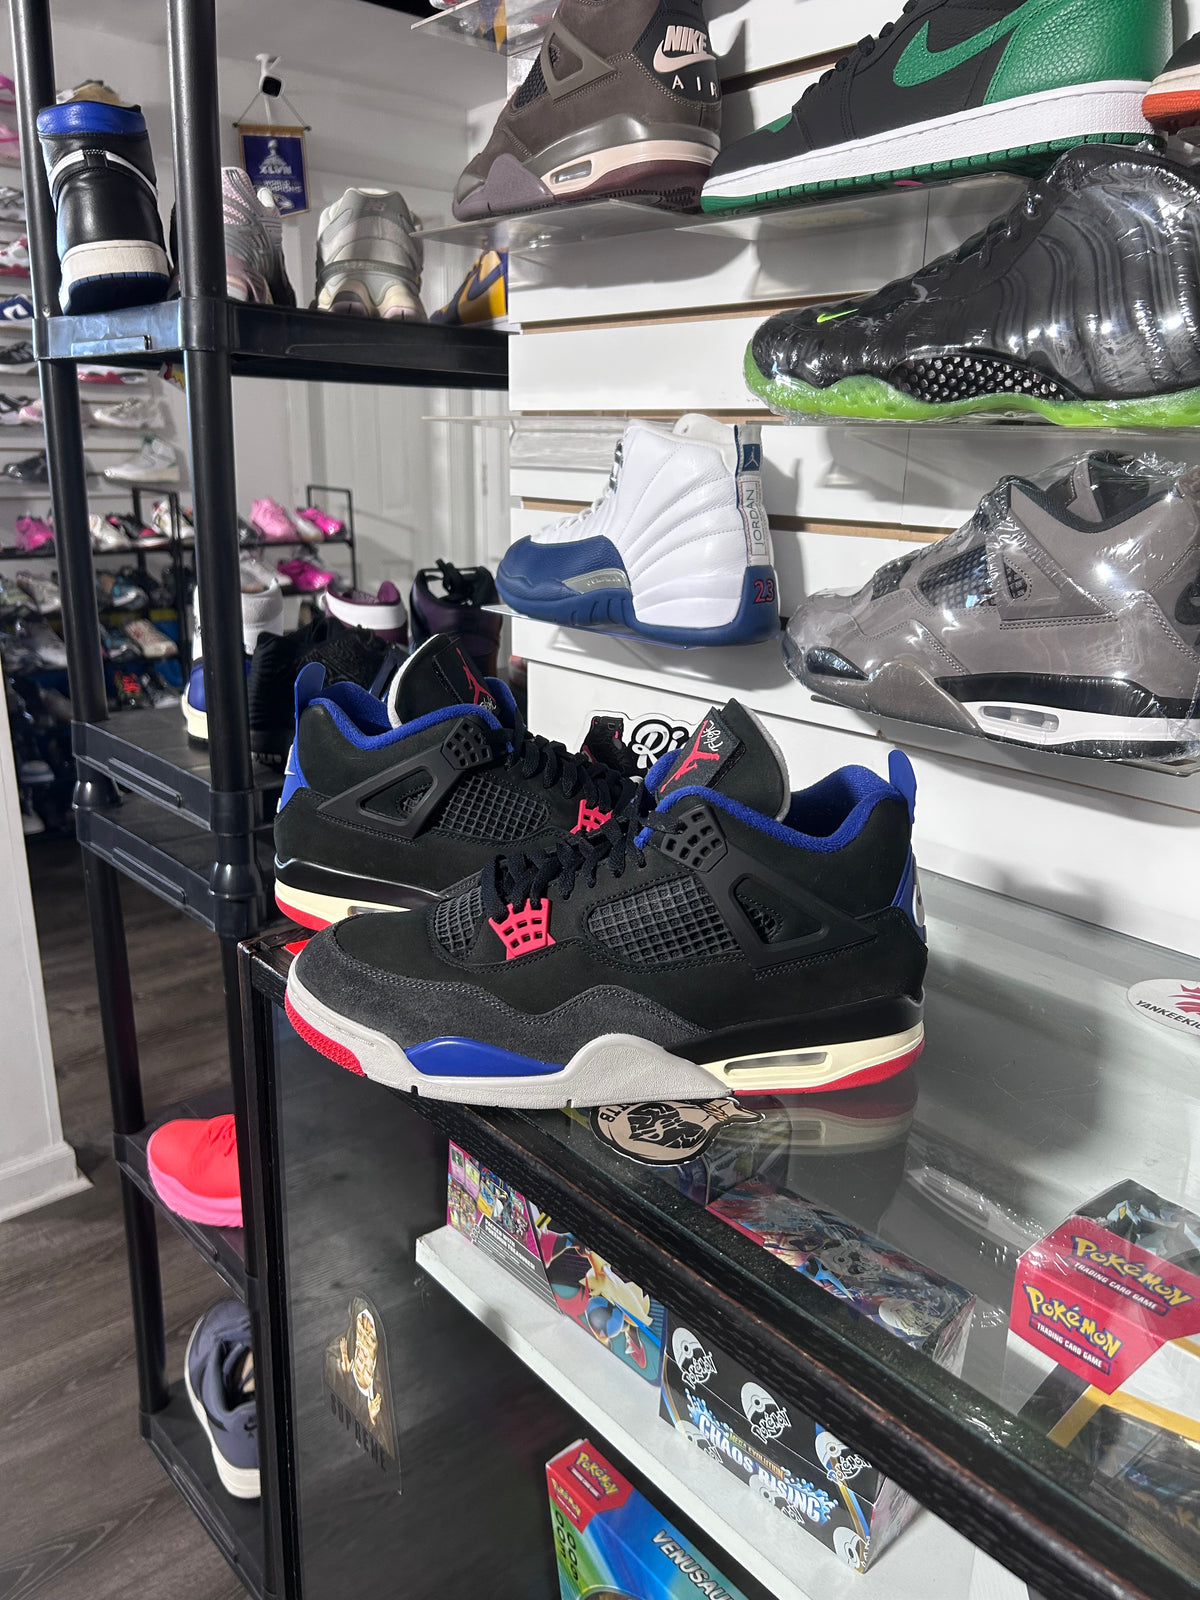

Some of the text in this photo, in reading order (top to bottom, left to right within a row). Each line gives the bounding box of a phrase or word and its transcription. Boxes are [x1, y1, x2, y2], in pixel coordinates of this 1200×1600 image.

[663, 25, 707, 54] NIKE
[672, 75, 718, 98] AIR
[746, 489, 765, 546] JORDAN
[753, 579, 775, 604] 23
[502, 1234, 516, 1248] WITH
[1073, 1261, 1158, 1311] TRADING CARD GAME
[1036, 1321, 1103, 1368] TRADING CARD GAME
[699, 1414, 821, 1522] CHAOS RISING
